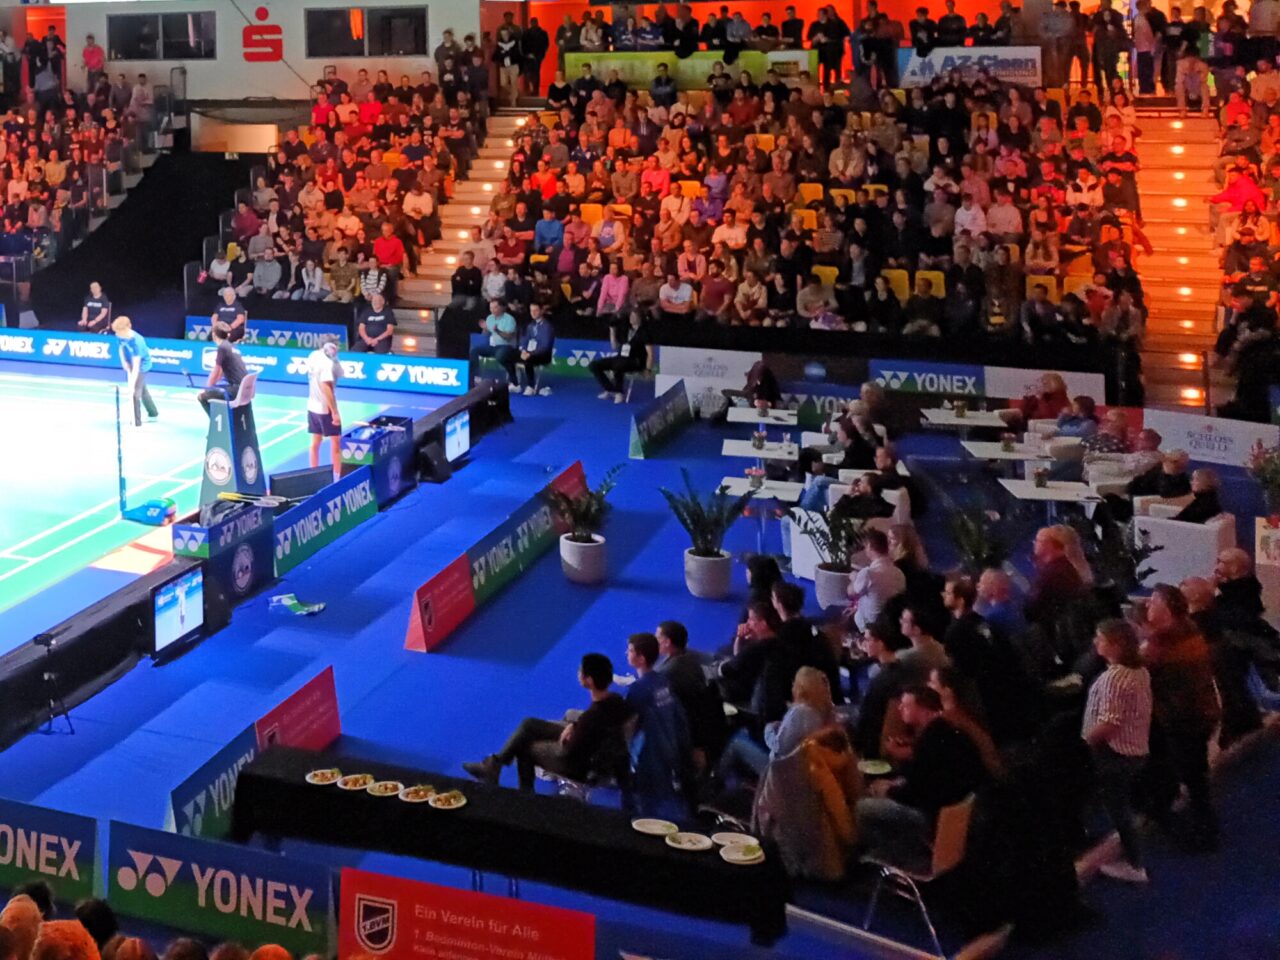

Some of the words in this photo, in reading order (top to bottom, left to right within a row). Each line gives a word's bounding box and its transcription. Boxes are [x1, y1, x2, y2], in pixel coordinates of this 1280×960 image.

[69, 339, 112, 359] YONEX
[408, 366, 461, 388] YONEX
[913, 372, 977, 395] YONEX
[215, 415, 223, 432] 1
[240, 414, 247, 430] 1
[234, 507, 263, 537] YONEX
[293, 508, 325, 547] YONEX
[342, 479, 374, 515] YONEX
[487, 535, 516, 576] YONEX
[191, 863, 313, 933] YONEX
[414, 904, 437, 919] Ein
[441, 910, 485, 929] Verein
[489, 918, 509, 935] für
[512, 925, 540, 941] Alle
